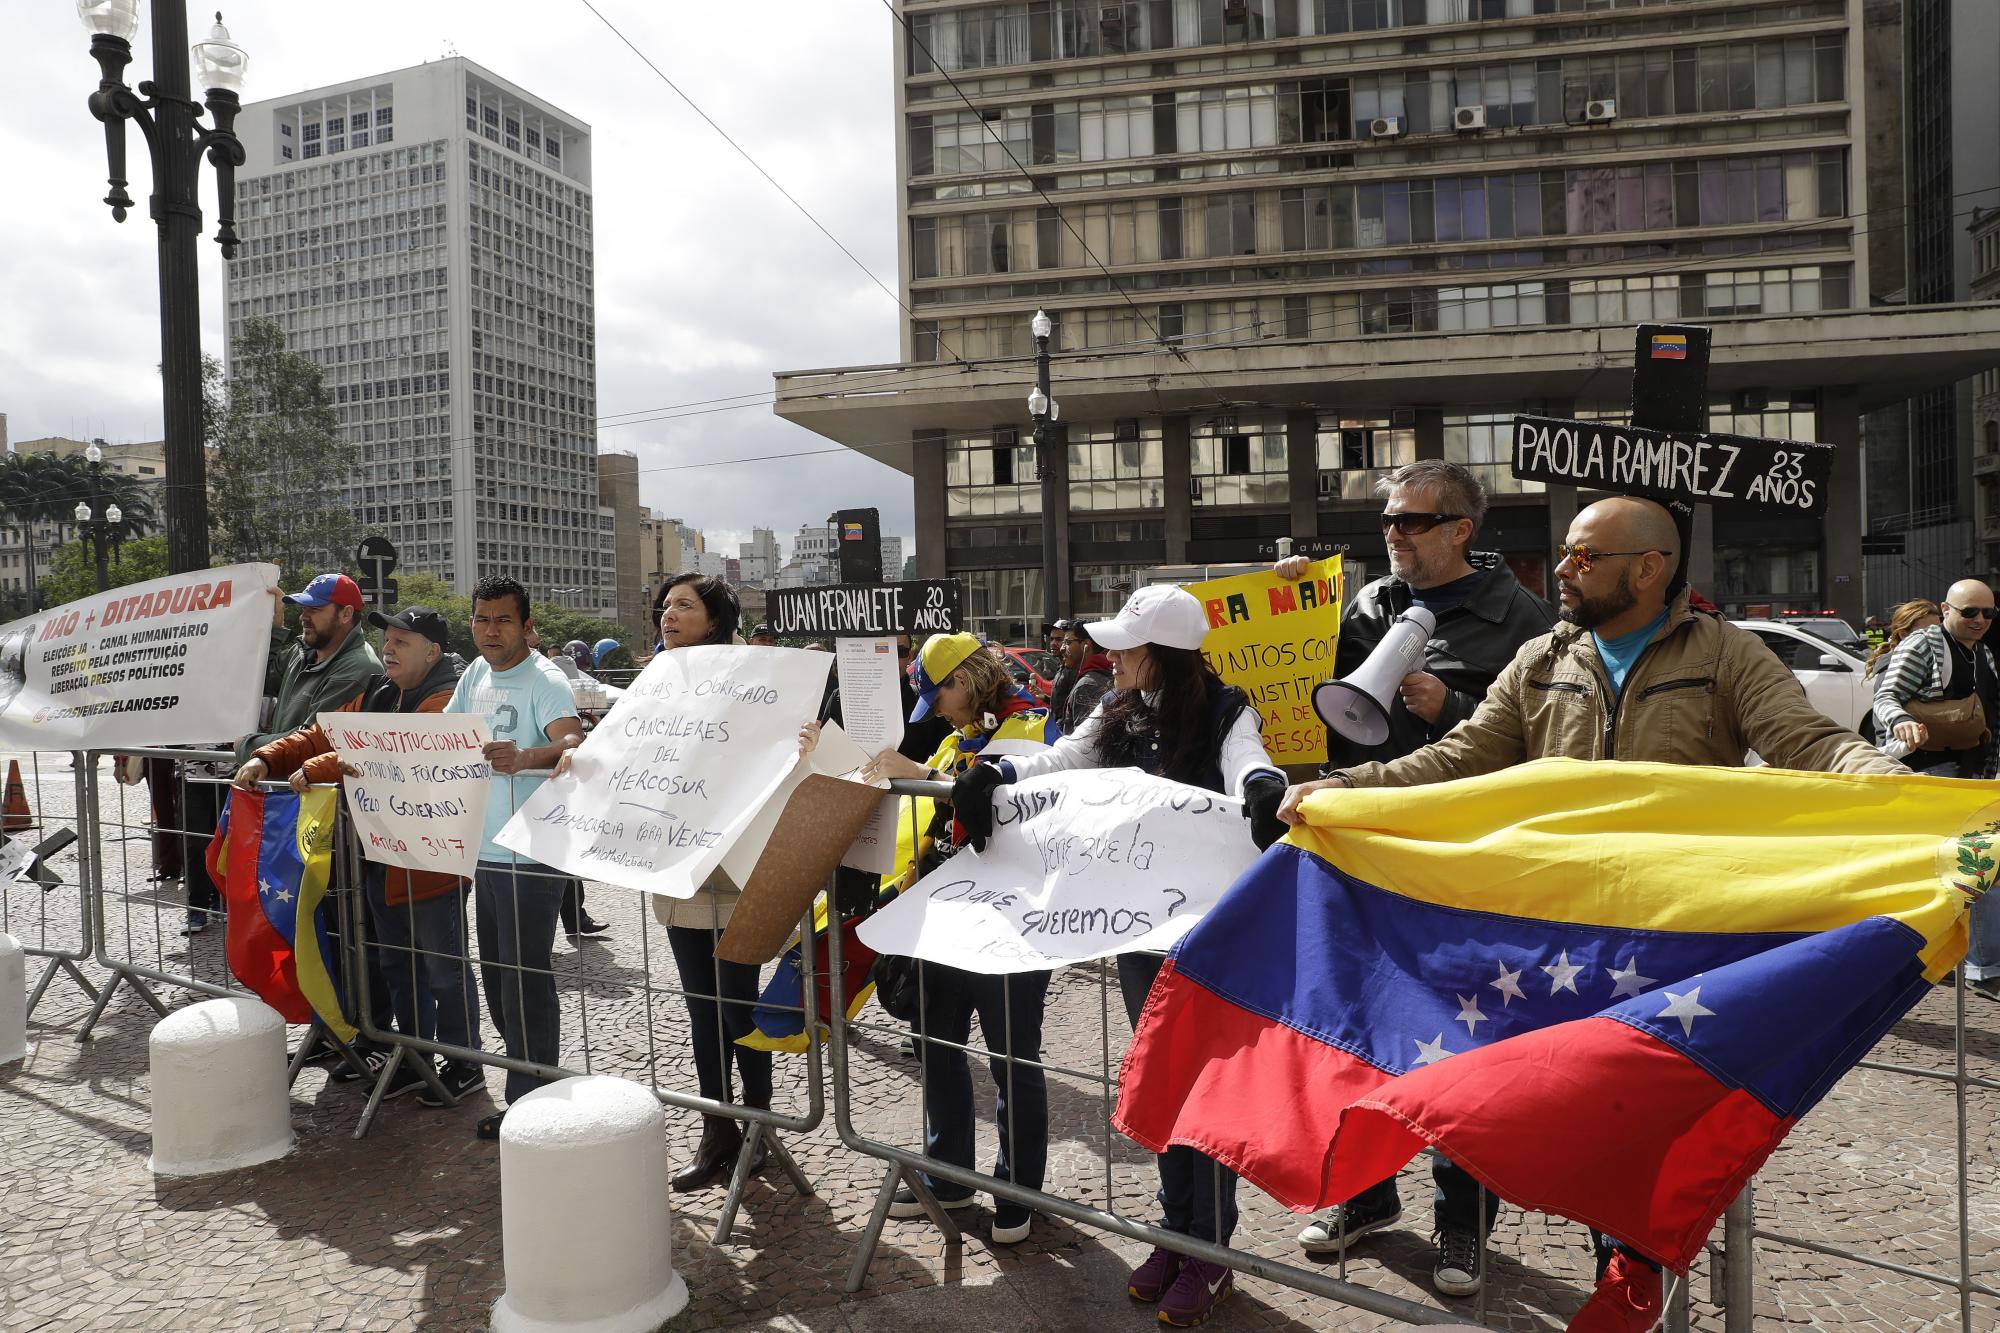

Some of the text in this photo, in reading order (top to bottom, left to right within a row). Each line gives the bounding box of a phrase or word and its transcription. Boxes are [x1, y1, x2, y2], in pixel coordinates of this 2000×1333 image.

[1518, 422, 1741, 498] PAOLA RAMIREZ
[1769, 450, 1806, 479] 23
[1312, 542, 1350, 551] Mano
[38, 609, 80, 642] NÃO
[100, 580, 232, 628] DITADURA
[774, 587, 904, 634] JUAN PERNALETE
[926, 586, 943, 608] 20
[100, 634, 128, 650] CANAL
[130, 622, 208, 646] HUMANITÁRIO
[51, 644, 187, 678] RESPEITO PELA CONSTITUIÇÃO
[50, 663, 184, 695] LIBERAÇÃO PRESOS POLÍTICOS
[625, 716, 729, 743] CANCILLERES
[652, 746, 680, 763] DEL
[608, 765, 708, 800] MERCOSUR
[422, 836, 464, 860] 347
[636, 821, 662, 842] PARA
[668, 819, 723, 849] VENEZ
